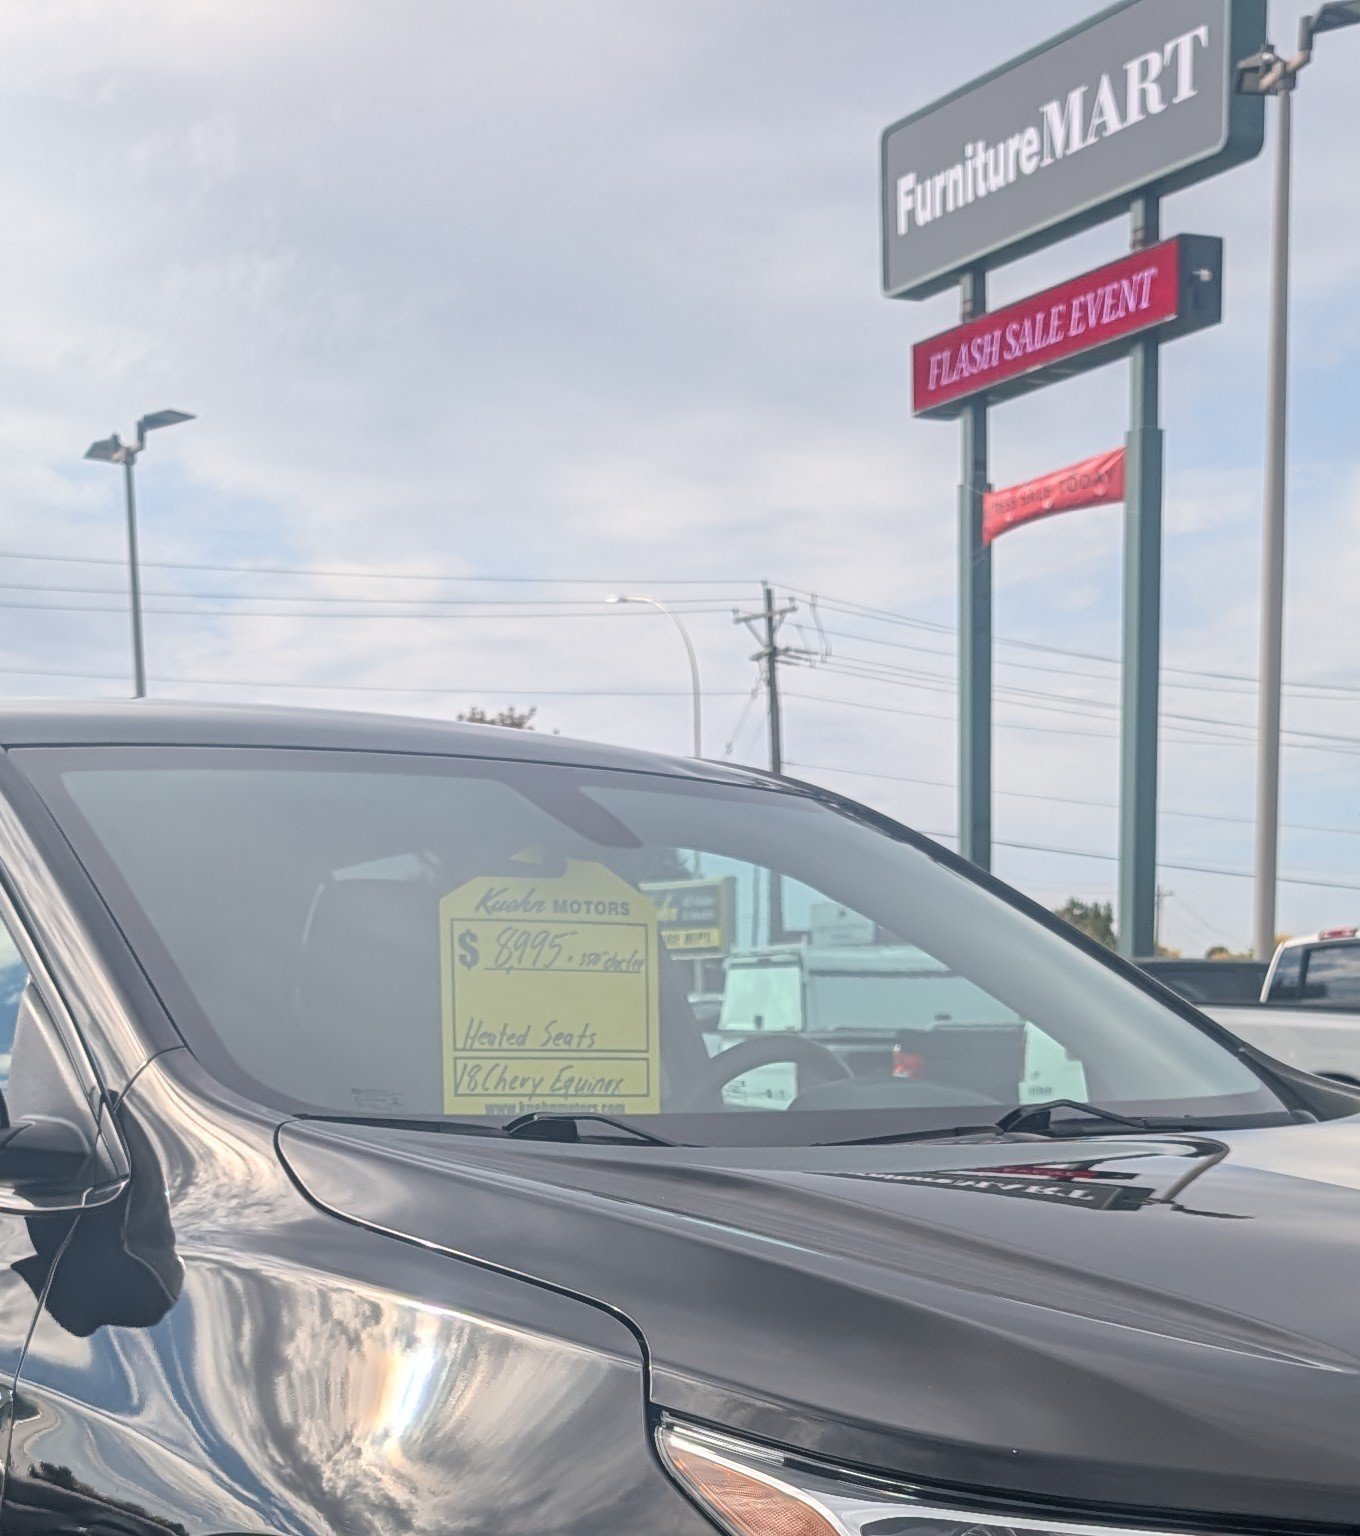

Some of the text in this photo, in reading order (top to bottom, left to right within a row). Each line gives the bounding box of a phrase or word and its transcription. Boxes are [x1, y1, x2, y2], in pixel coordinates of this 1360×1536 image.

[896, 25, 1209, 235] FurnitureMART
[928, 268, 1159, 390] FLASH SALE EVENT
[553, 900, 630, 915] MOTORS
[458, 929, 479, 969] $
[462, 1018, 596, 1049] Heated Seats
